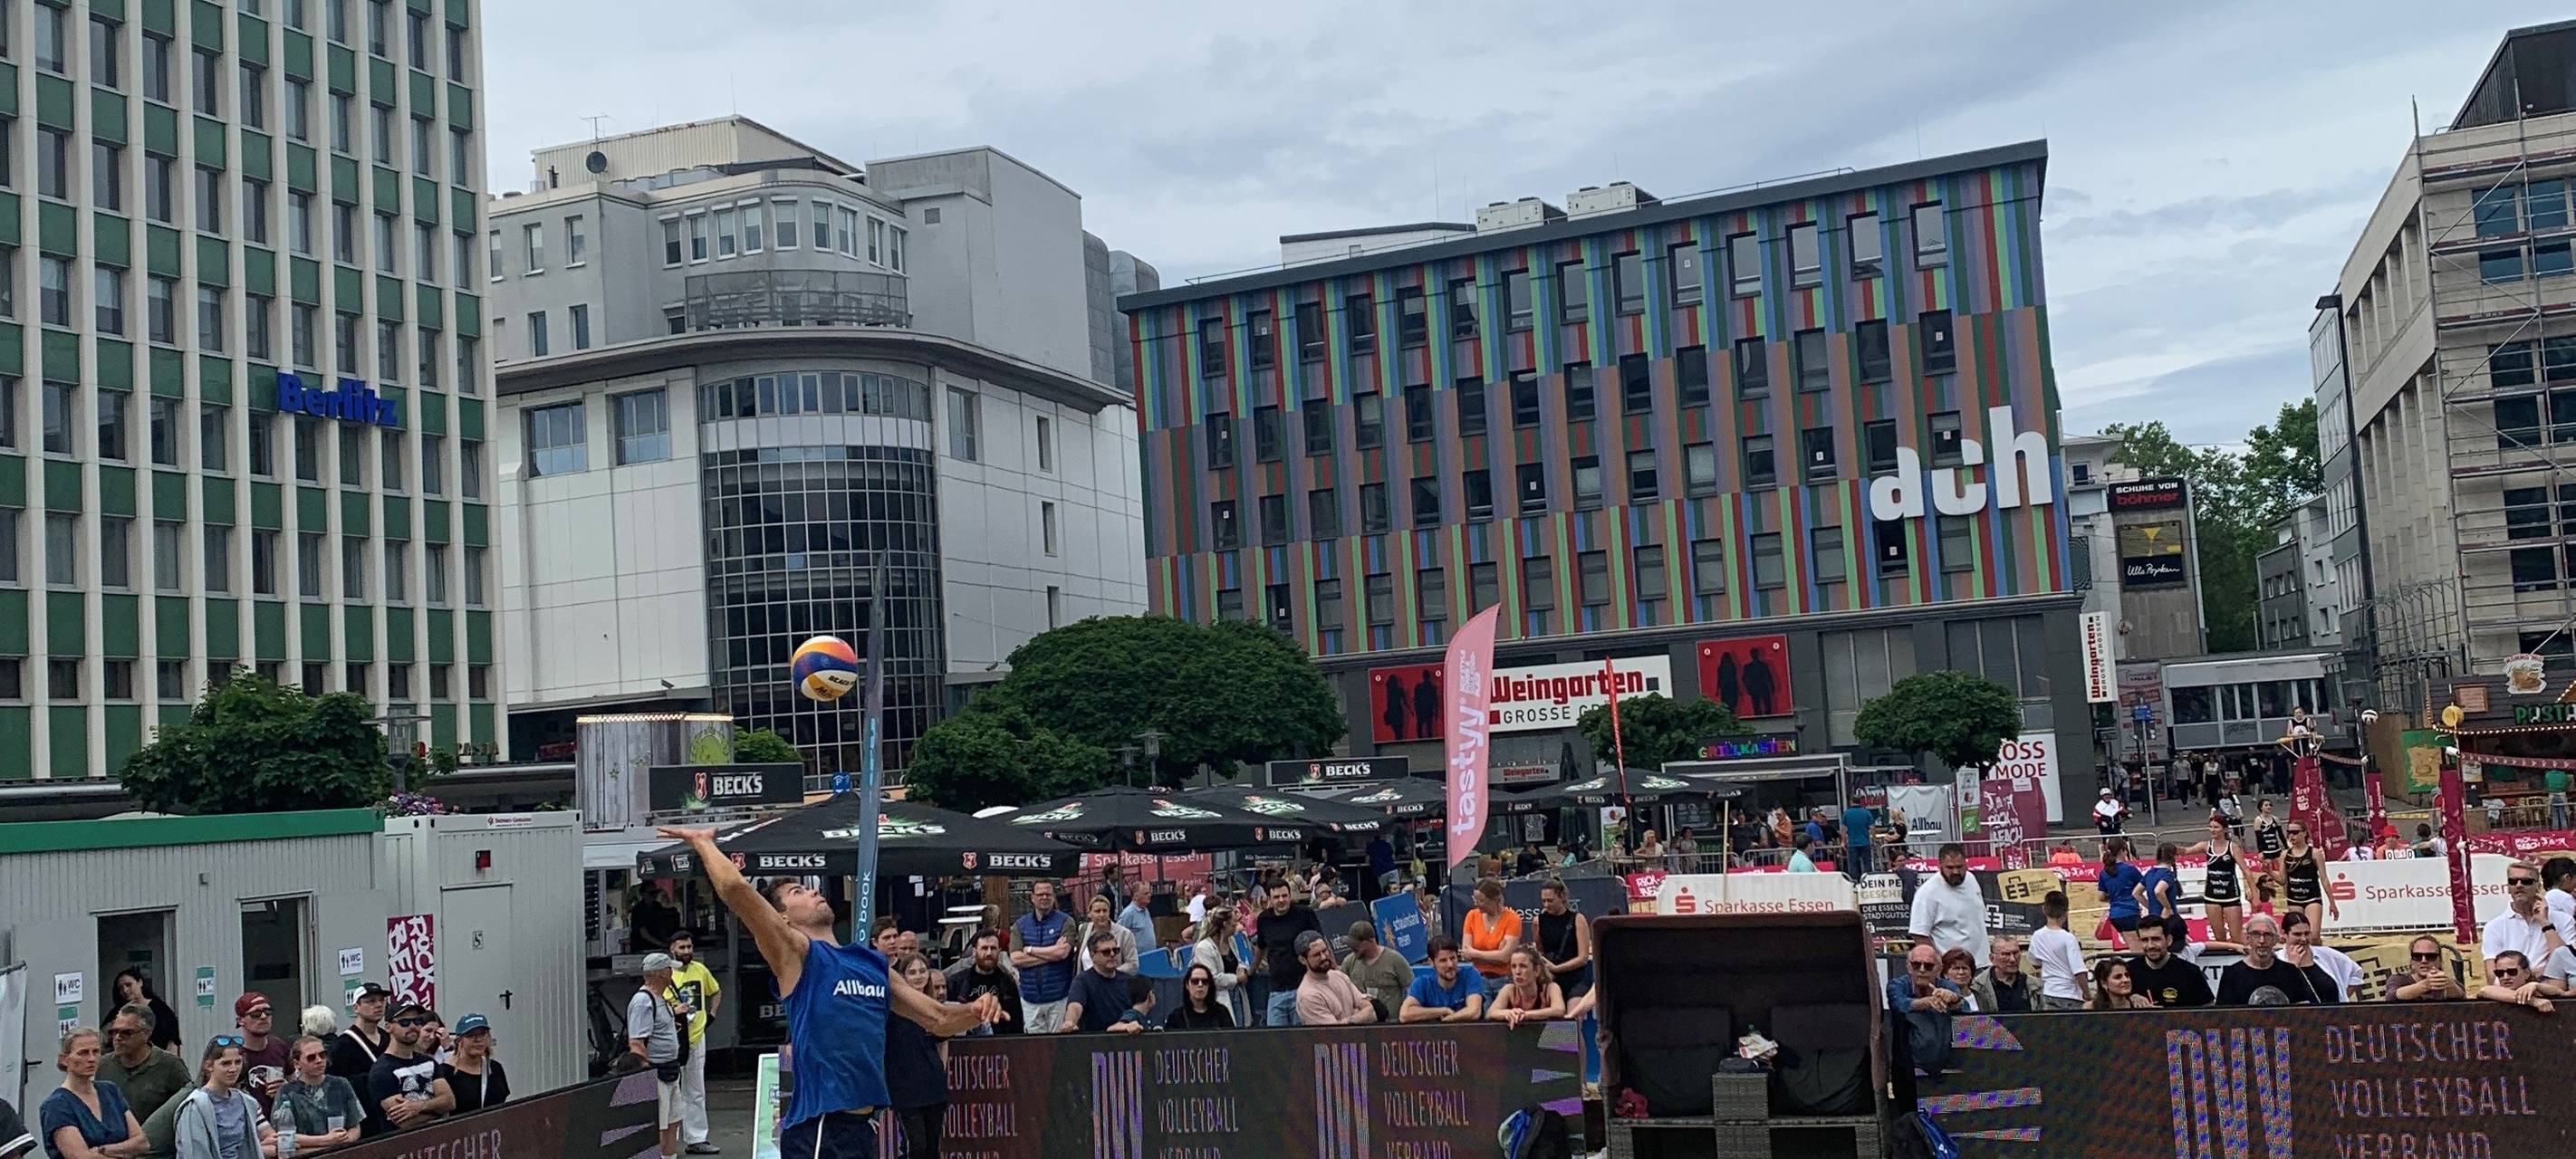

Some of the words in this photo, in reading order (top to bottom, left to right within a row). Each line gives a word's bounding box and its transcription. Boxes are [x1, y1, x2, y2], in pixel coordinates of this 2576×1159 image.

[277, 372, 398, 426] Berlitz
[2116, 484, 2155, 494] SCHUHE
[2158, 482, 2178, 491] VON
[2128, 564, 2145, 577] Ulla
[2088, 624, 2100, 698] Weingarten
[1491, 669, 1643, 704] Weingarten
[1503, 705, 1571, 724] GROSSE
[2002, 741, 2045, 761] OSS
[1325, 762, 1370, 777] BECK'S
[1451, 705, 1485, 836] tastyy
[1995, 762, 2047, 779] MODE
[712, 773, 763, 796] BECK'S
[1911, 817, 1942, 831] Allbau
[1150, 829, 1186, 842] BECK'S
[1269, 829, 1302, 840] BECK'S
[759, 853, 826, 868] BECK'S
[989, 853, 1051, 868] BECK'S
[2366, 885, 2453, 902] Sparkasse
[2474, 884, 2508, 896] ssen
[1705, 899, 1783, 915] Sparkasse
[1789, 898, 1834, 913] Essen
[350, 953, 361, 963] WC
[67, 978, 81, 990] WC
[833, 979, 885, 998] Allbau
[2325, 1020, 2514, 1064] DEUTSCHER
[1154, 1047, 1230, 1085] DEUTSCHER
[1380, 1039, 1460, 1078] DEUTSCHER
[947, 1054, 1010, 1091] EUTSCHER
[2330, 1075, 2537, 1118] VOLLEYBALL
[1158, 1096, 1240, 1133] VOLLEYBALL
[1384, 1089, 1471, 1126] VOLLEYBALL
